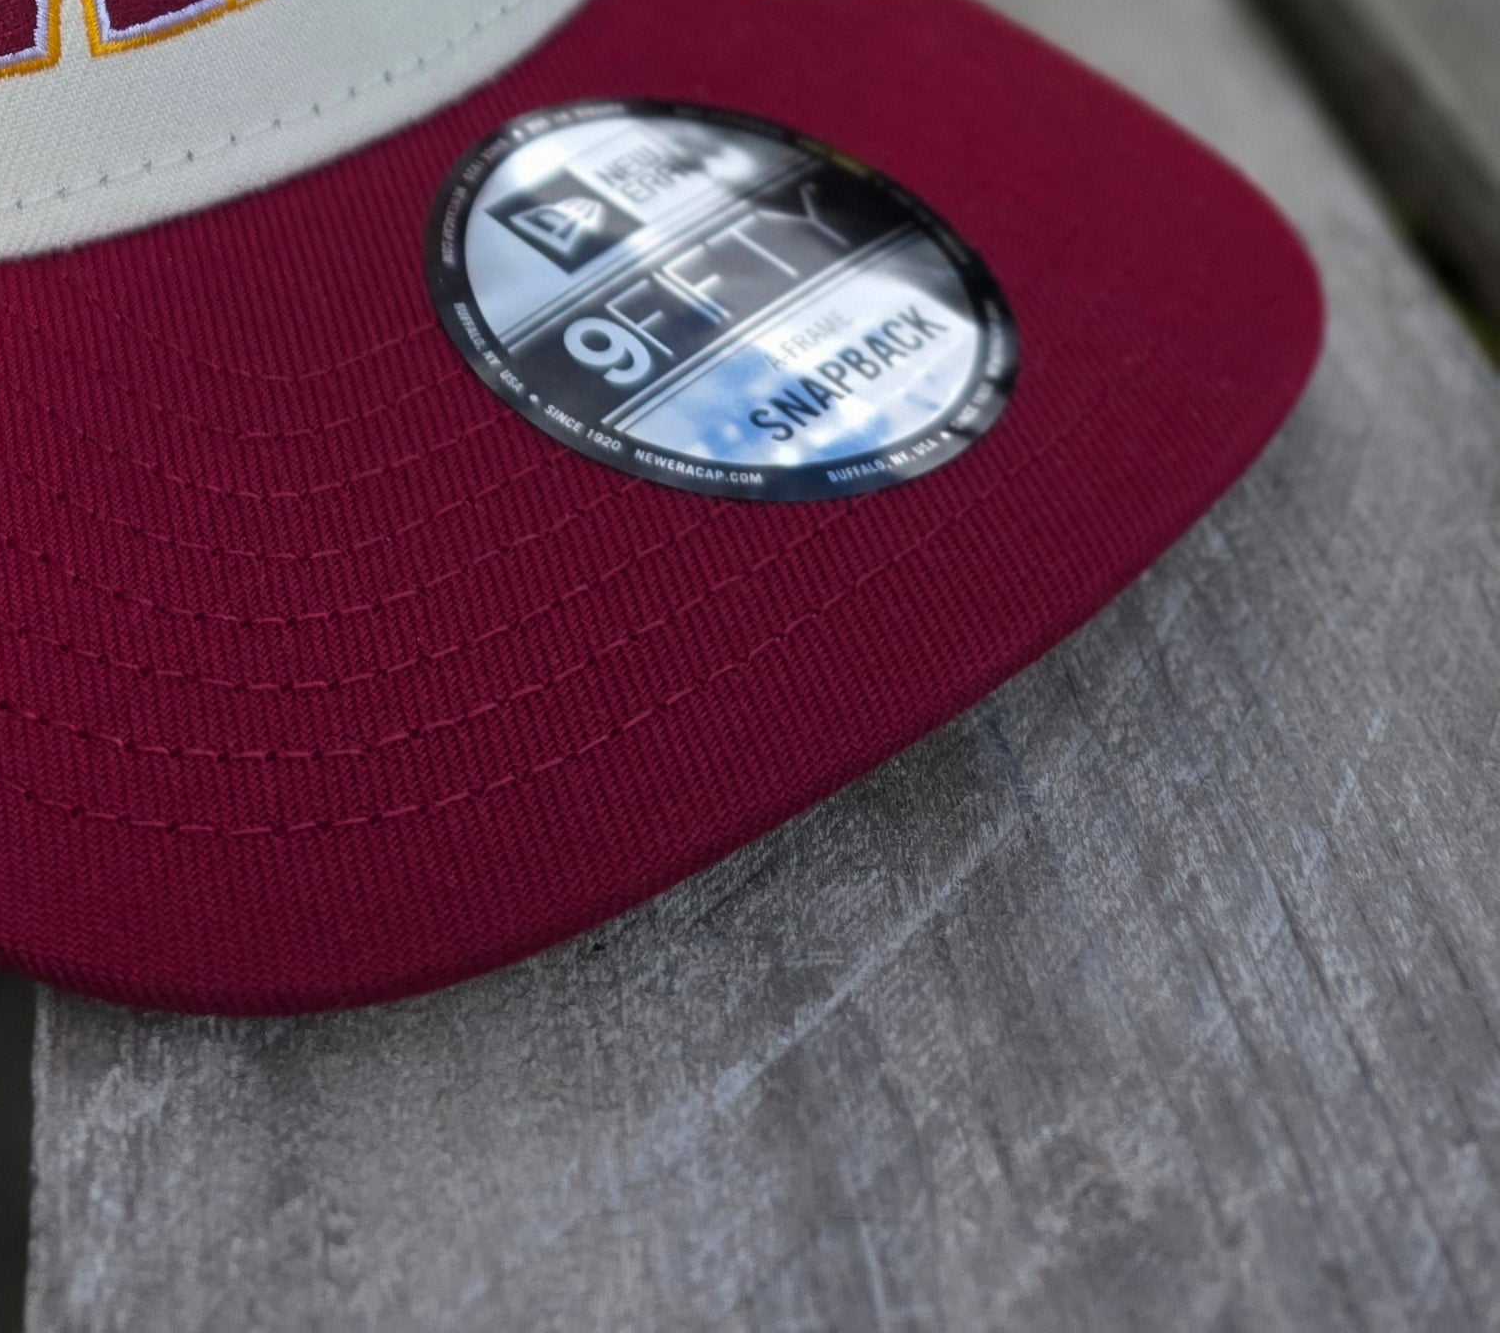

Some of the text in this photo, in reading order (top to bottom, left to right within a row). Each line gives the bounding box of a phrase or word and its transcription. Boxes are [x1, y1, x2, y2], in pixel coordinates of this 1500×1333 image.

[747, 304, 948, 442] SNAPBACK
[764, 307, 853, 371] A-FRAME
[499, 369, 524, 393] USA
[543, 403, 584, 433] SINCE
[584, 427, 623, 452] 1920
[633, 447, 764, 485] NEWERACAP.COM
